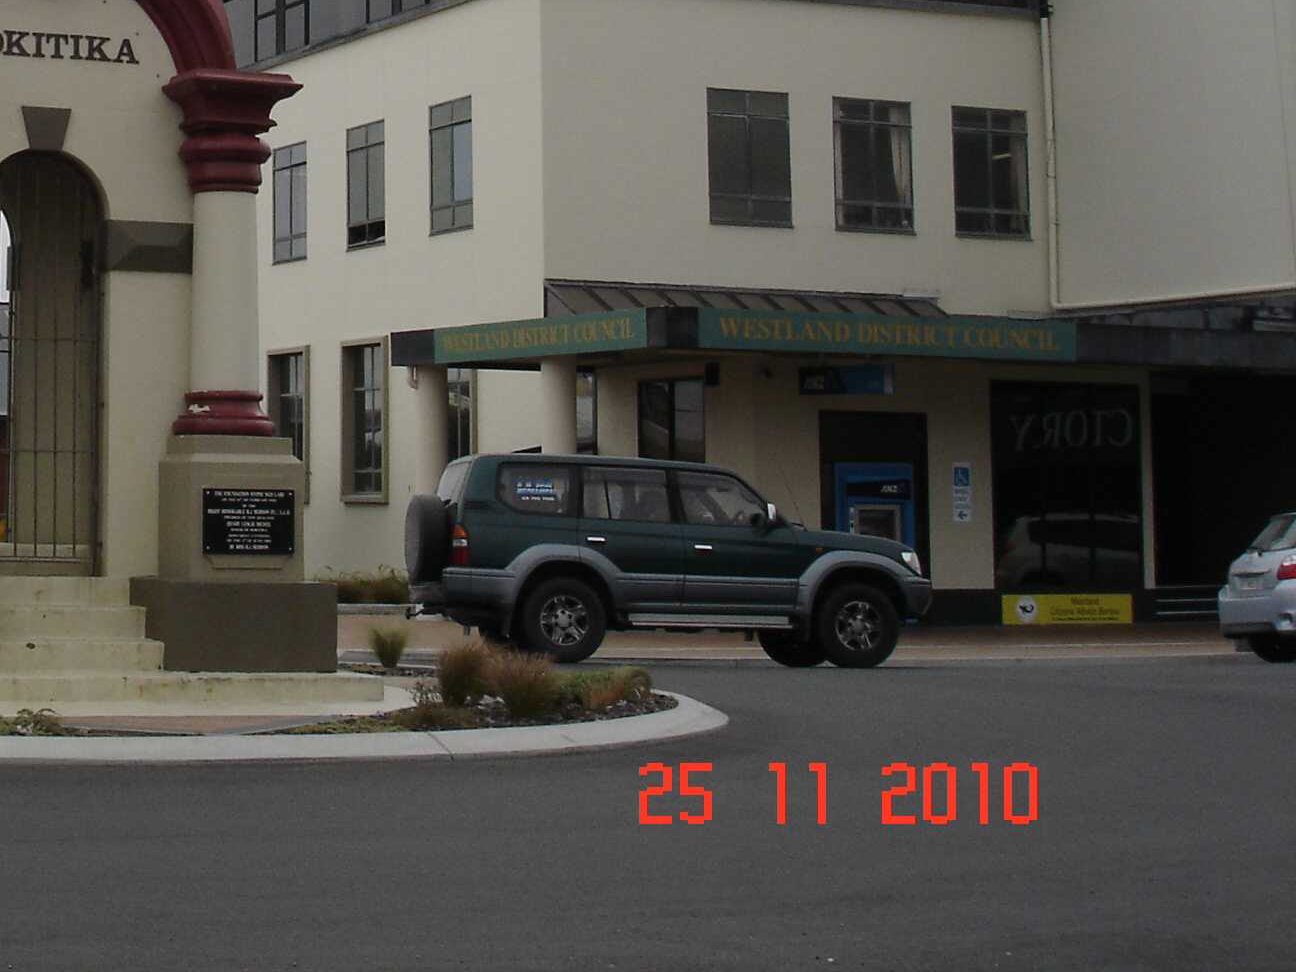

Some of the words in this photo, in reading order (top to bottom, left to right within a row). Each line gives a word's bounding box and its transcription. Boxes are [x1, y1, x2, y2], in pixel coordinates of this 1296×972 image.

[575, 317, 633, 343] COUNCIL
[719, 317, 850, 343] WESTLAND
[856, 322, 958, 348] DISTRICT
[963, 326, 1058, 351] COUNCIL
